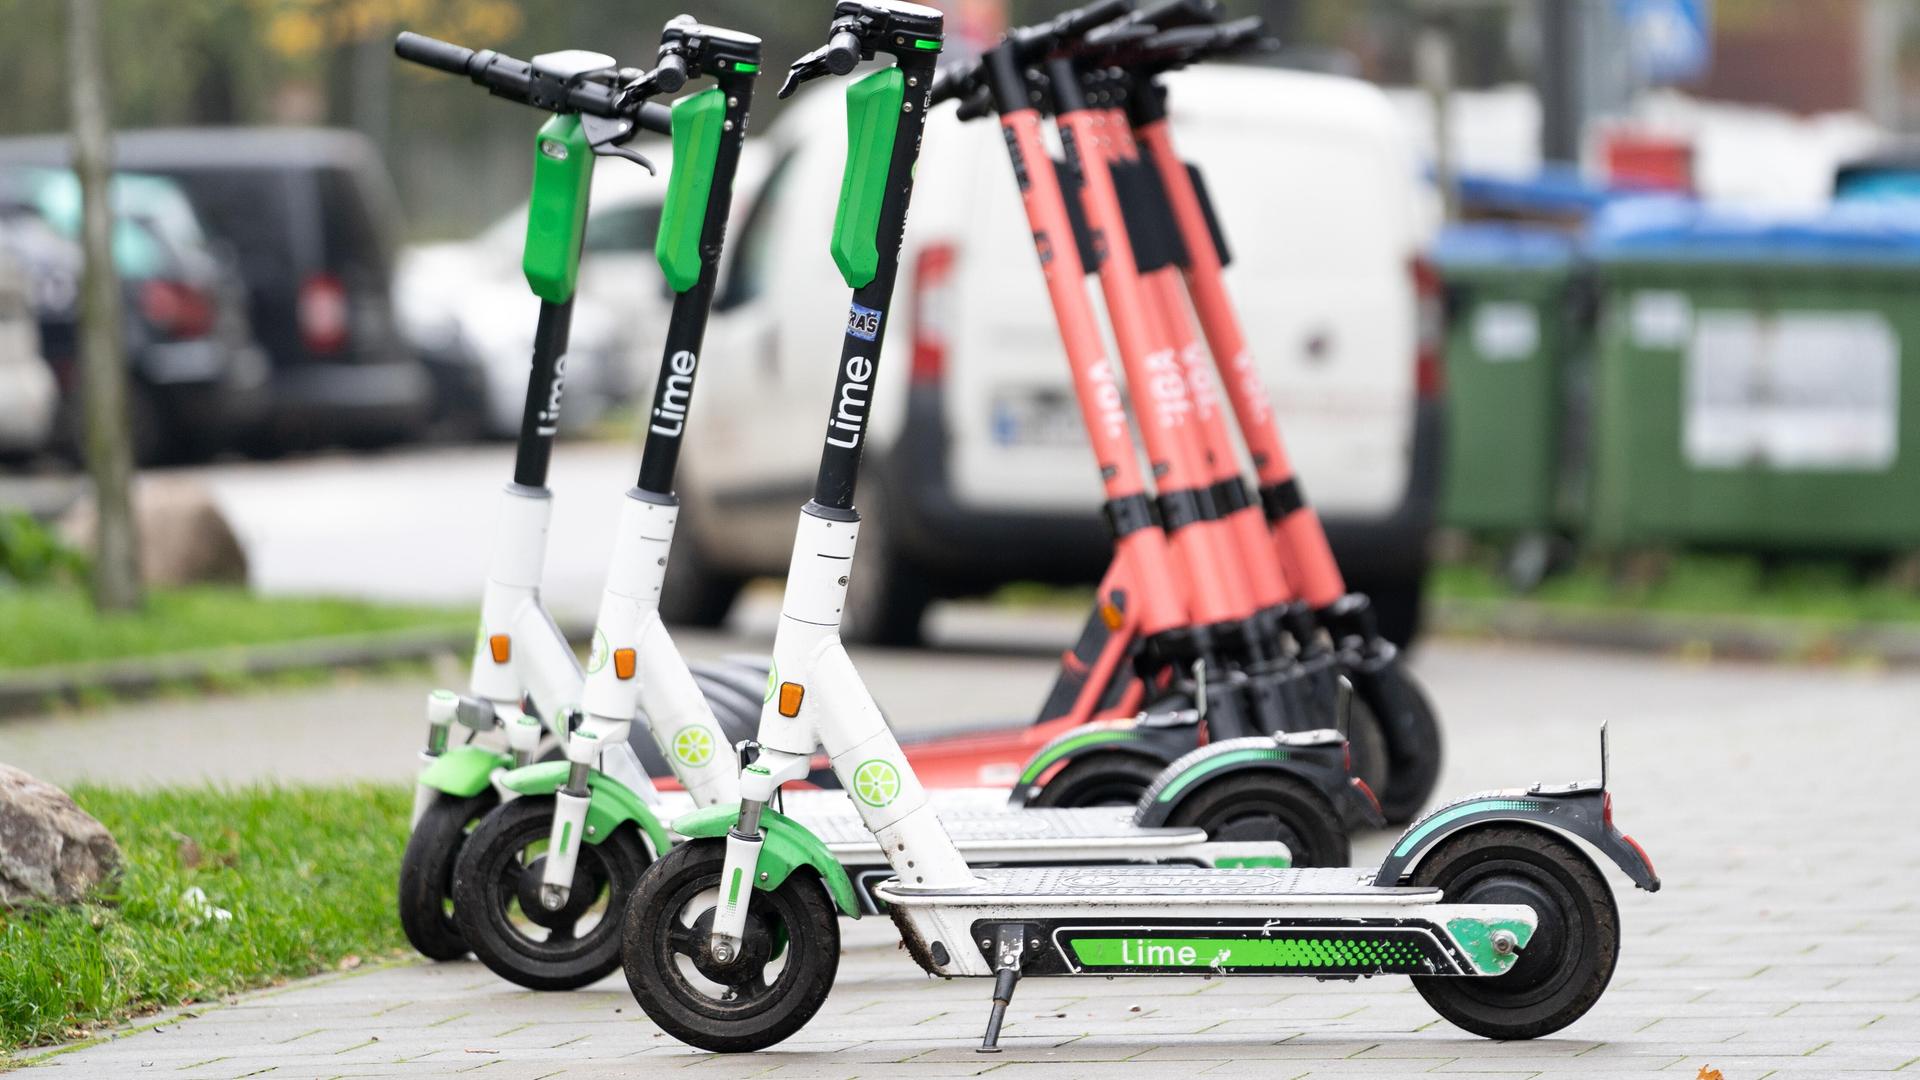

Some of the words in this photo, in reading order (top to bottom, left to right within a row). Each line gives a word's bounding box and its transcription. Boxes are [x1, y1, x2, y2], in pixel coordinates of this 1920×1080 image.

[652, 350, 697, 437] Lime
[827, 356, 872, 449] Lime
[1122, 939, 1197, 965] Lime
